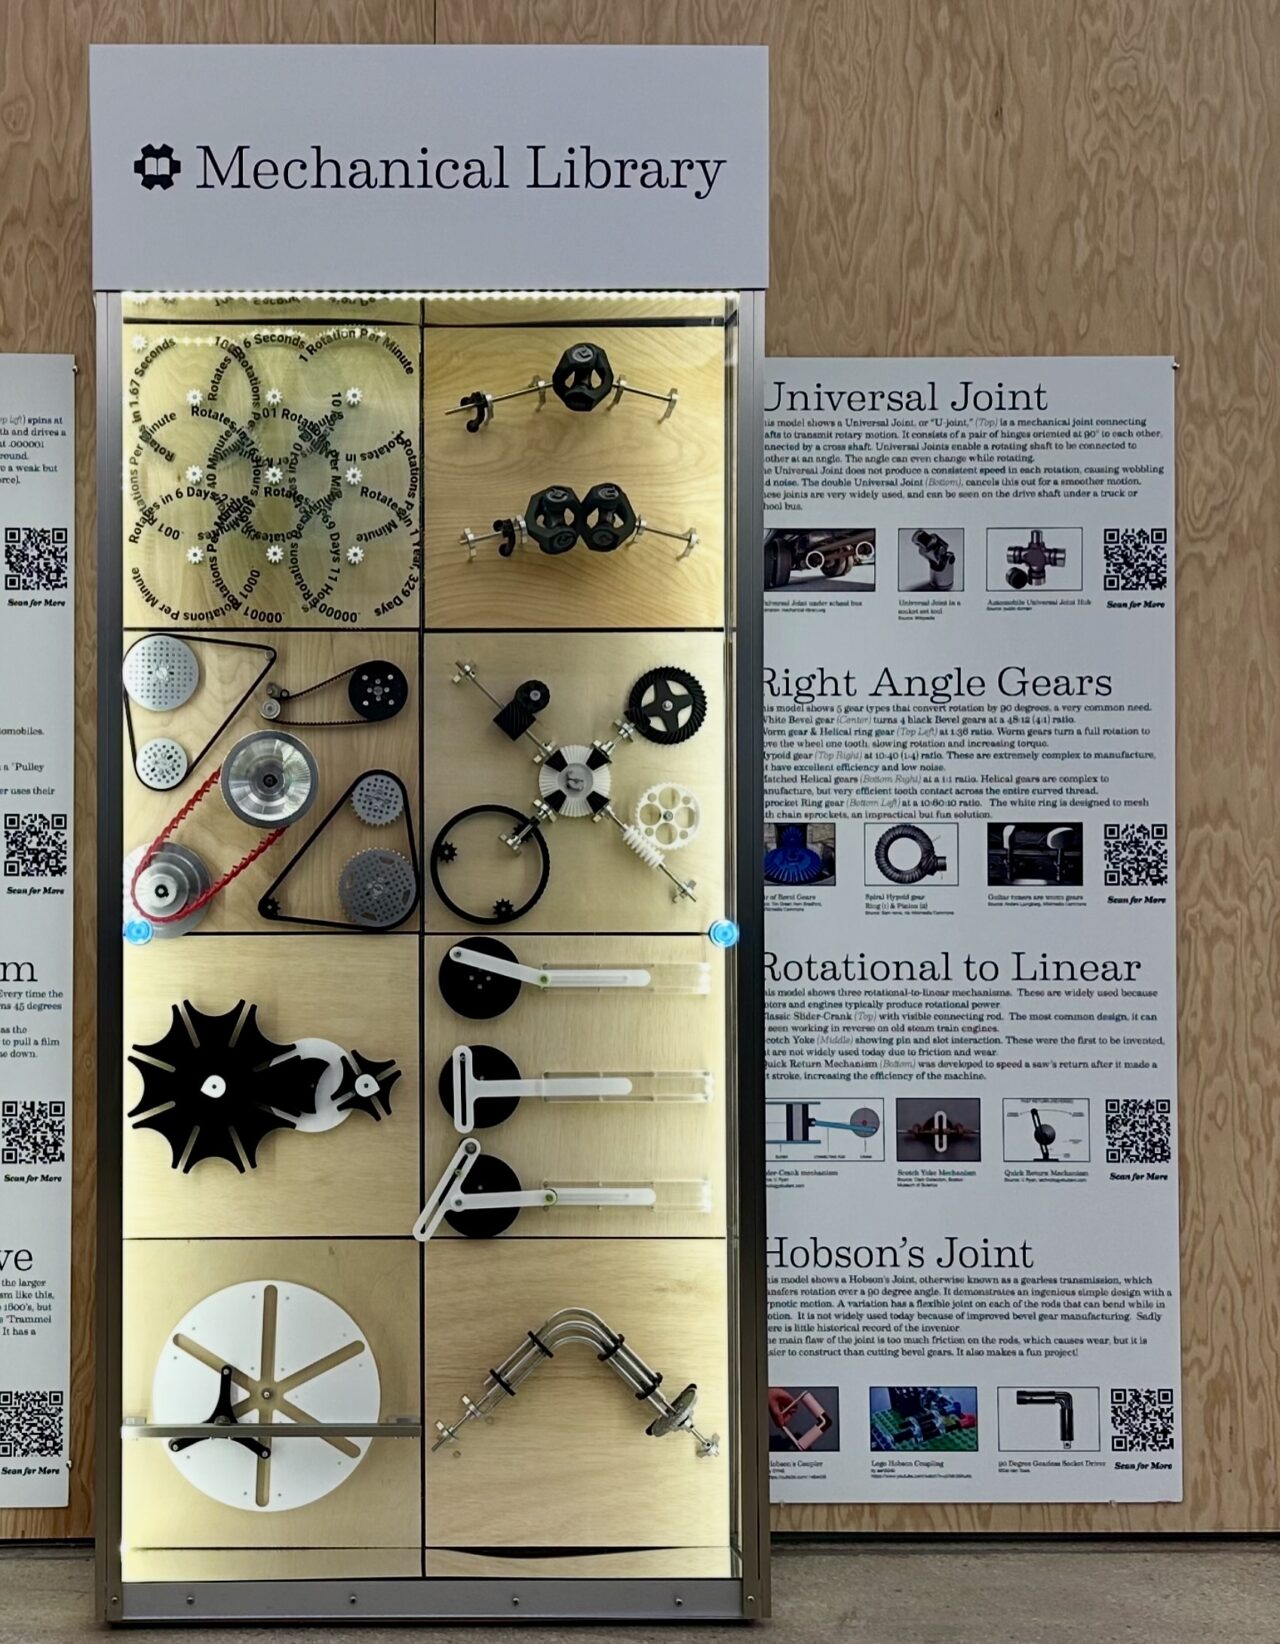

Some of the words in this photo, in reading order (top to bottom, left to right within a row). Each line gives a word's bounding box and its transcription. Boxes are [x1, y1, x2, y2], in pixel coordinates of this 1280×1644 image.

[196, 145, 509, 189] Mechanical
[526, 145, 726, 199] Library
[134, 338, 177, 378] Seconds
[305, 329, 357, 356] Rotation
[359, 328, 381, 344] Per
[381, 337, 415, 376] Minute
[207, 355, 232, 401] Rotates
[242, 337, 252, 349] 6
[253, 332, 306, 350] Seconds
[129, 378, 141, 408] 1.67
[951, 381, 1047, 412] Joint
[845, 454, 862, 463] The
[865, 454, 889, 465] angle
[933, 454, 966, 464] change
[969, 453, 994, 462] while
[128, 500, 161, 544] Rotates
[160, 493, 174, 505] in
[175, 487, 184, 499] 6
[356, 519, 399, 543] Minute
[329, 531, 341, 564] Days
[288, 541, 314, 602] Rotations
[131, 566, 159, 608] Minute
[401, 573, 420, 598] 329
[7, 598, 28, 606] Scan
[28, 599, 42, 608] for
[44, 599, 65, 607] More
[158, 603, 180, 621] Per
[374, 594, 405, 617] Days
[1106, 600, 1127, 609] Scan
[1128, 600, 1141, 610] for
[1143, 600, 1164, 608] More
[868, 667, 985, 704] Angle
[998, 666, 1111, 697] Gears
[770, 763, 791, 771] have
[793, 763, 833, 771] excellent
[836, 763, 879, 773] efficiency
[882, 763, 899, 772] and
[901, 763, 917, 771] low
[6, 886, 27, 894] Scan
[27, 886, 41, 896] for
[42, 886, 64, 895] More
[1107, 896, 1128, 904] Scan
[1129, 896, 1142, 905] for
[1144, 896, 1166, 904] More
[963, 954, 998, 982] to
[1011, 952, 1141, 982] Linear
[804, 1072, 851, 1082] increasing
[853, 1071, 867, 1080] the
[870, 1071, 913, 1082] efficiency
[915, 1071, 925, 1080] of
[927, 1071, 941, 1080] the
[4, 1174, 24, 1182] Scan
[25, 1174, 38, 1184] for
[40, 1174, 61, 1182] More
[1109, 1172, 1130, 1181] Scan
[1131, 1172, 1144, 1182] for
[1146, 1172, 1167, 1181] More
[936, 1237, 1033, 1268] Joint
[784, 1324, 792, 1332] is
[794, 1323, 814, 1332] little
[816, 1323, 859, 1332] historical
[862, 1323, 891, 1332] record
[893, 1323, 903, 1332] of
[904, 1323, 919, 1332] the
[921, 1324, 959, 1332] inventor
[1, 1467, 22, 1475] Scan
[22, 1467, 36, 1476] for
[38, 1466, 59, 1475] More
[1114, 1462, 1135, 1470] Scan
[1135, 1462, 1149, 1471] for
[1150, 1462, 1172, 1470] More
